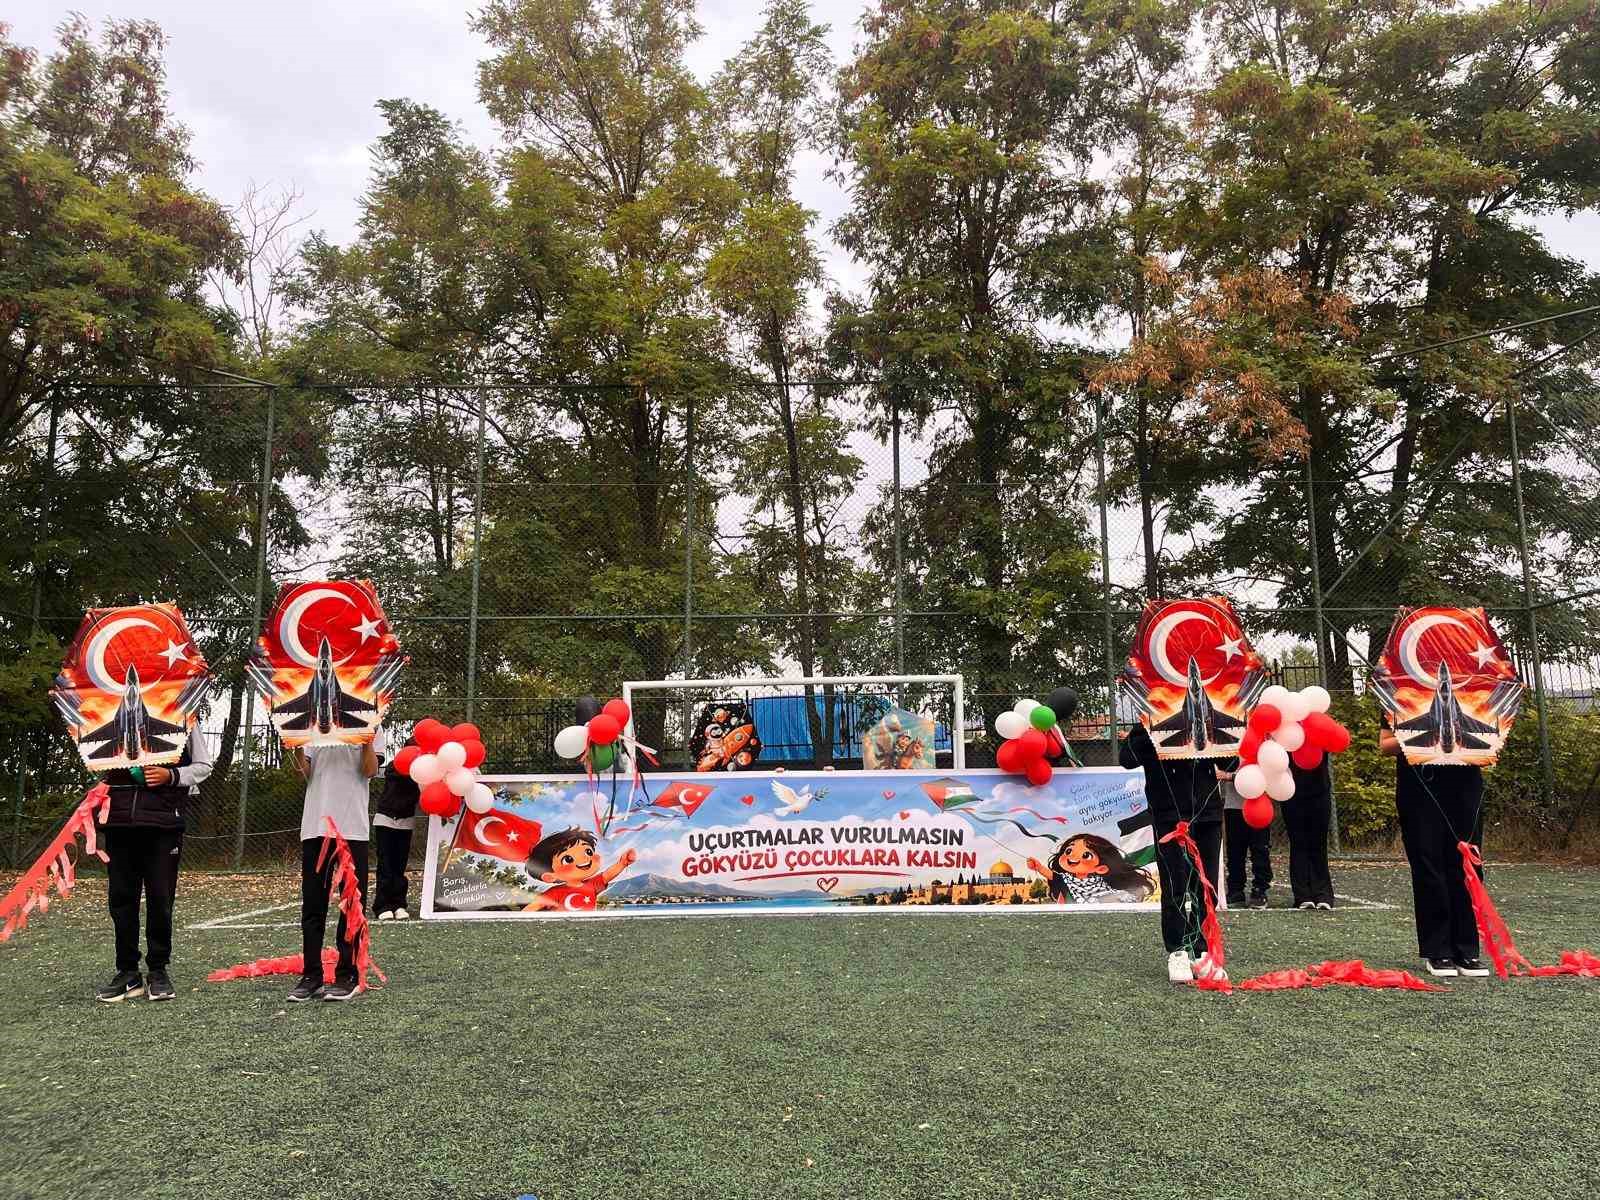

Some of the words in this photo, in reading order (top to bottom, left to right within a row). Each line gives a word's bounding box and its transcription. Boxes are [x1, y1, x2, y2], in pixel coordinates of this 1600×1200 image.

[1079, 803, 1097, 816] aynı
[1098, 788, 1141, 811] gökyüzüne
[688, 827, 824, 854] UÇURTMALAR
[830, 826, 964, 846] VURULMASIN
[681, 848, 778, 877] GÖKYÜZÜ
[784, 848, 900, 872] ÇOCUKLARA
[906, 849, 977, 869] KALSIN
